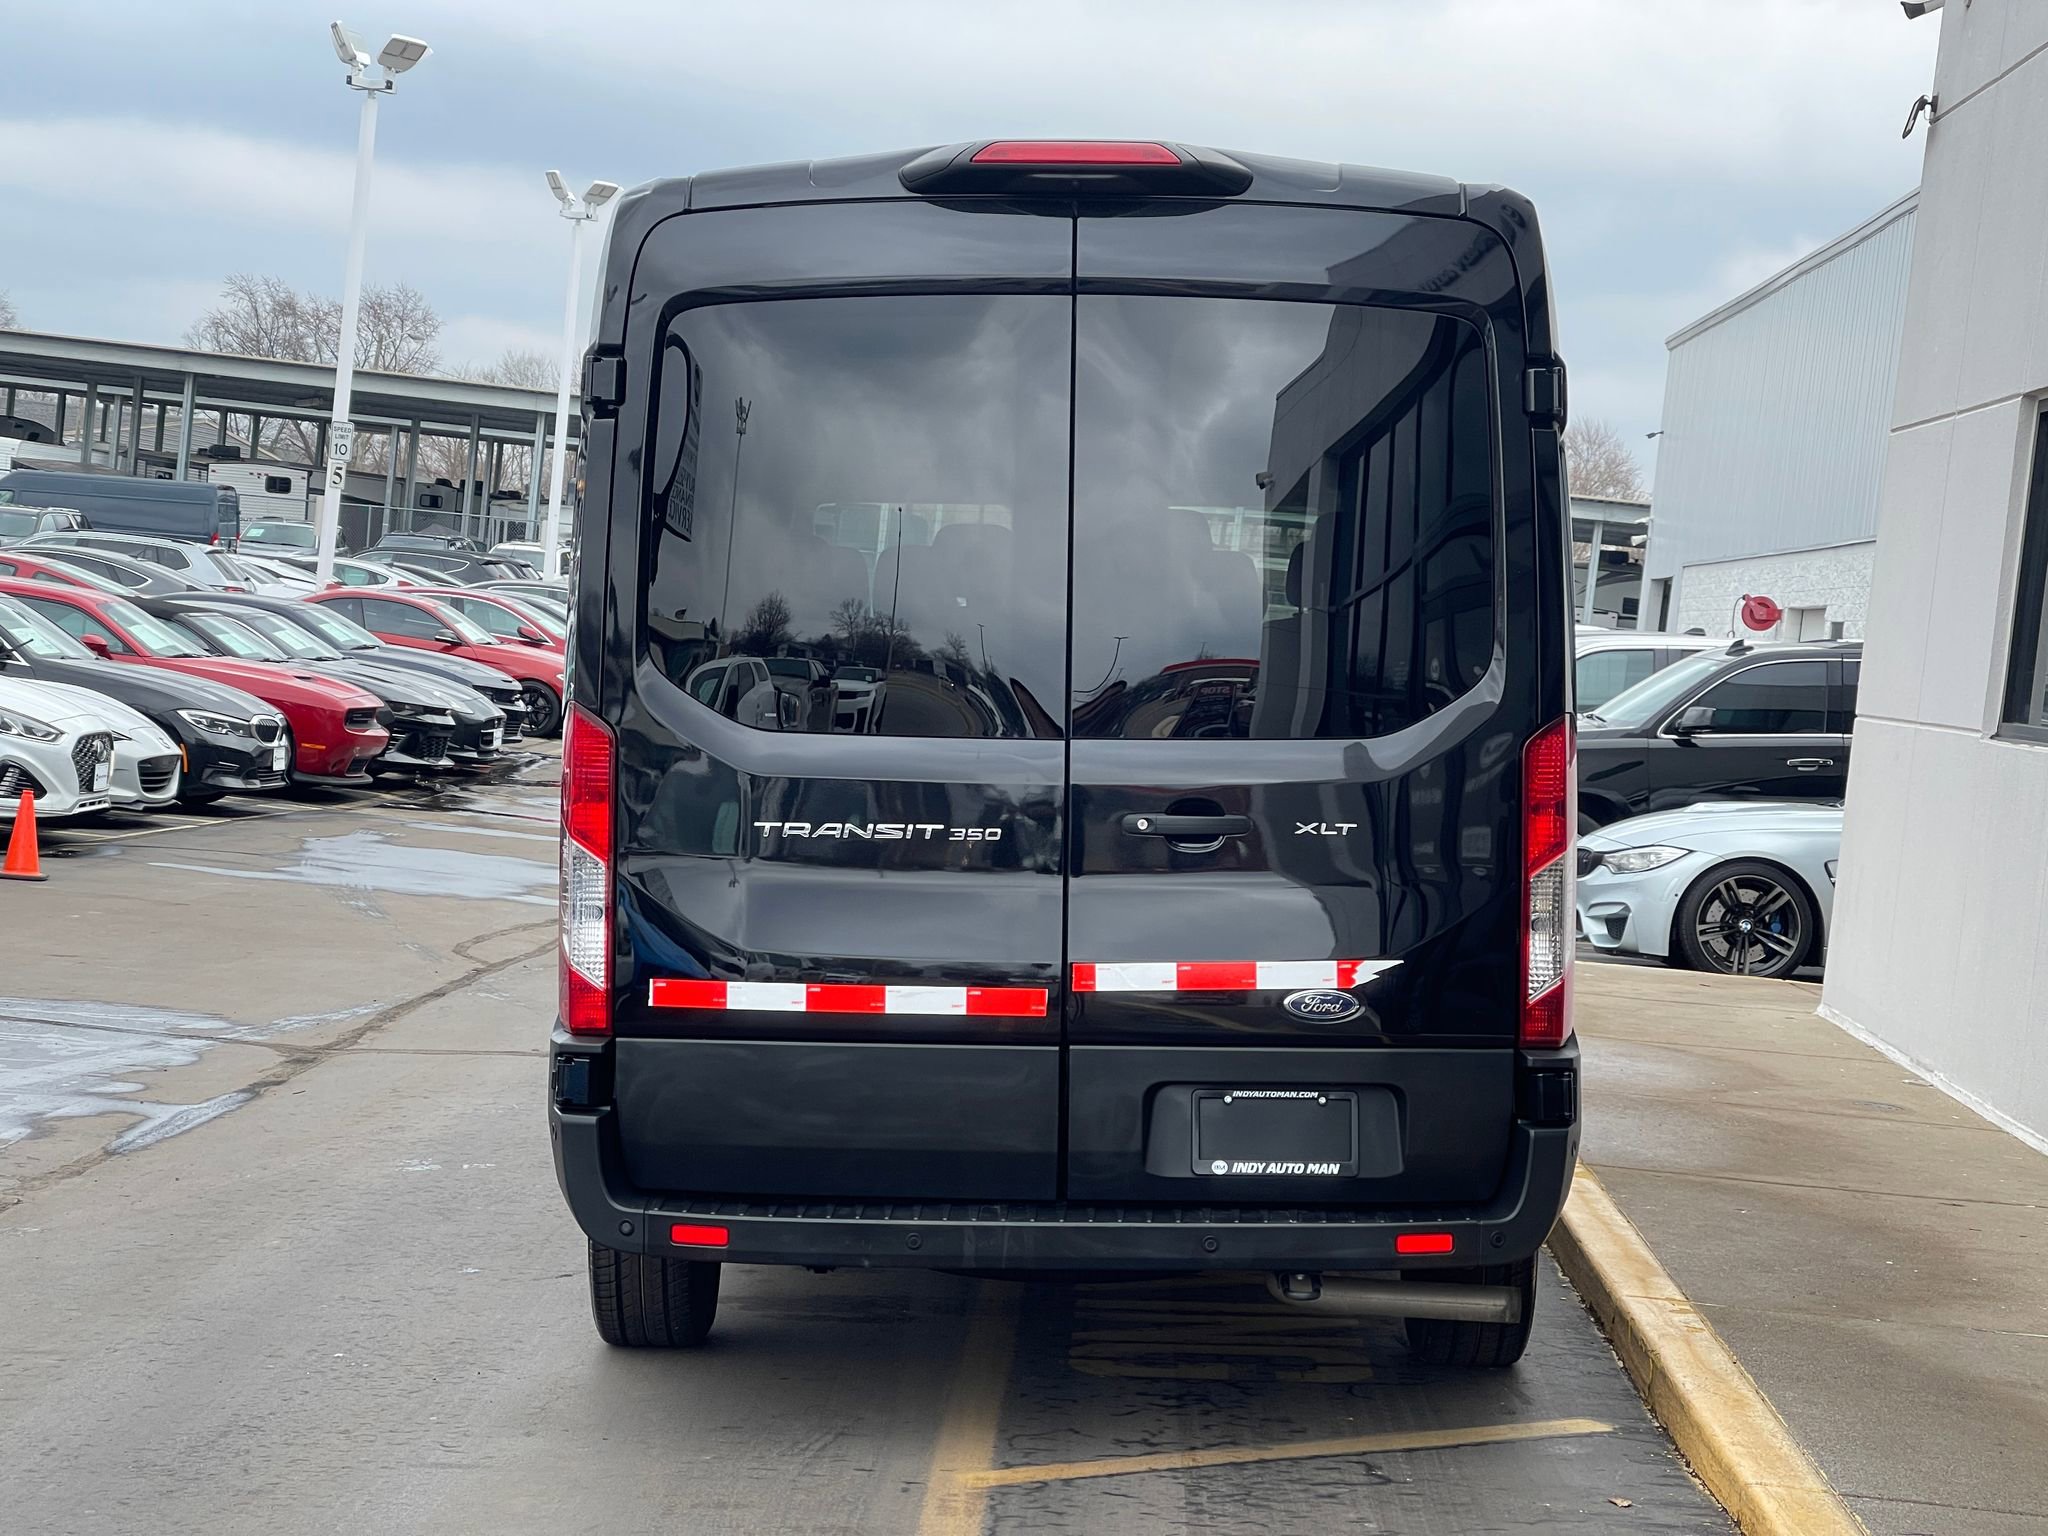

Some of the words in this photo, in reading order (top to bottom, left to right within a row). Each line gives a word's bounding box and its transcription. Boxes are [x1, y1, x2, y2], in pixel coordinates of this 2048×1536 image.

[334, 443, 348, 456] 10
[332, 466, 343, 485] 5
[753, 821, 945, 840] TRANSIT
[948, 827, 1002, 841] 350
[1294, 821, 1358, 836] XLT
[1300, 995, 1344, 1013] Ford
[1232, 1090, 1319, 1098] INDYAUTOMAN.COM
[1231, 1162, 1267, 1173] INDY
[1266, 1162, 1305, 1174] AUTO
[1306, 1163, 1341, 1175] MAN
